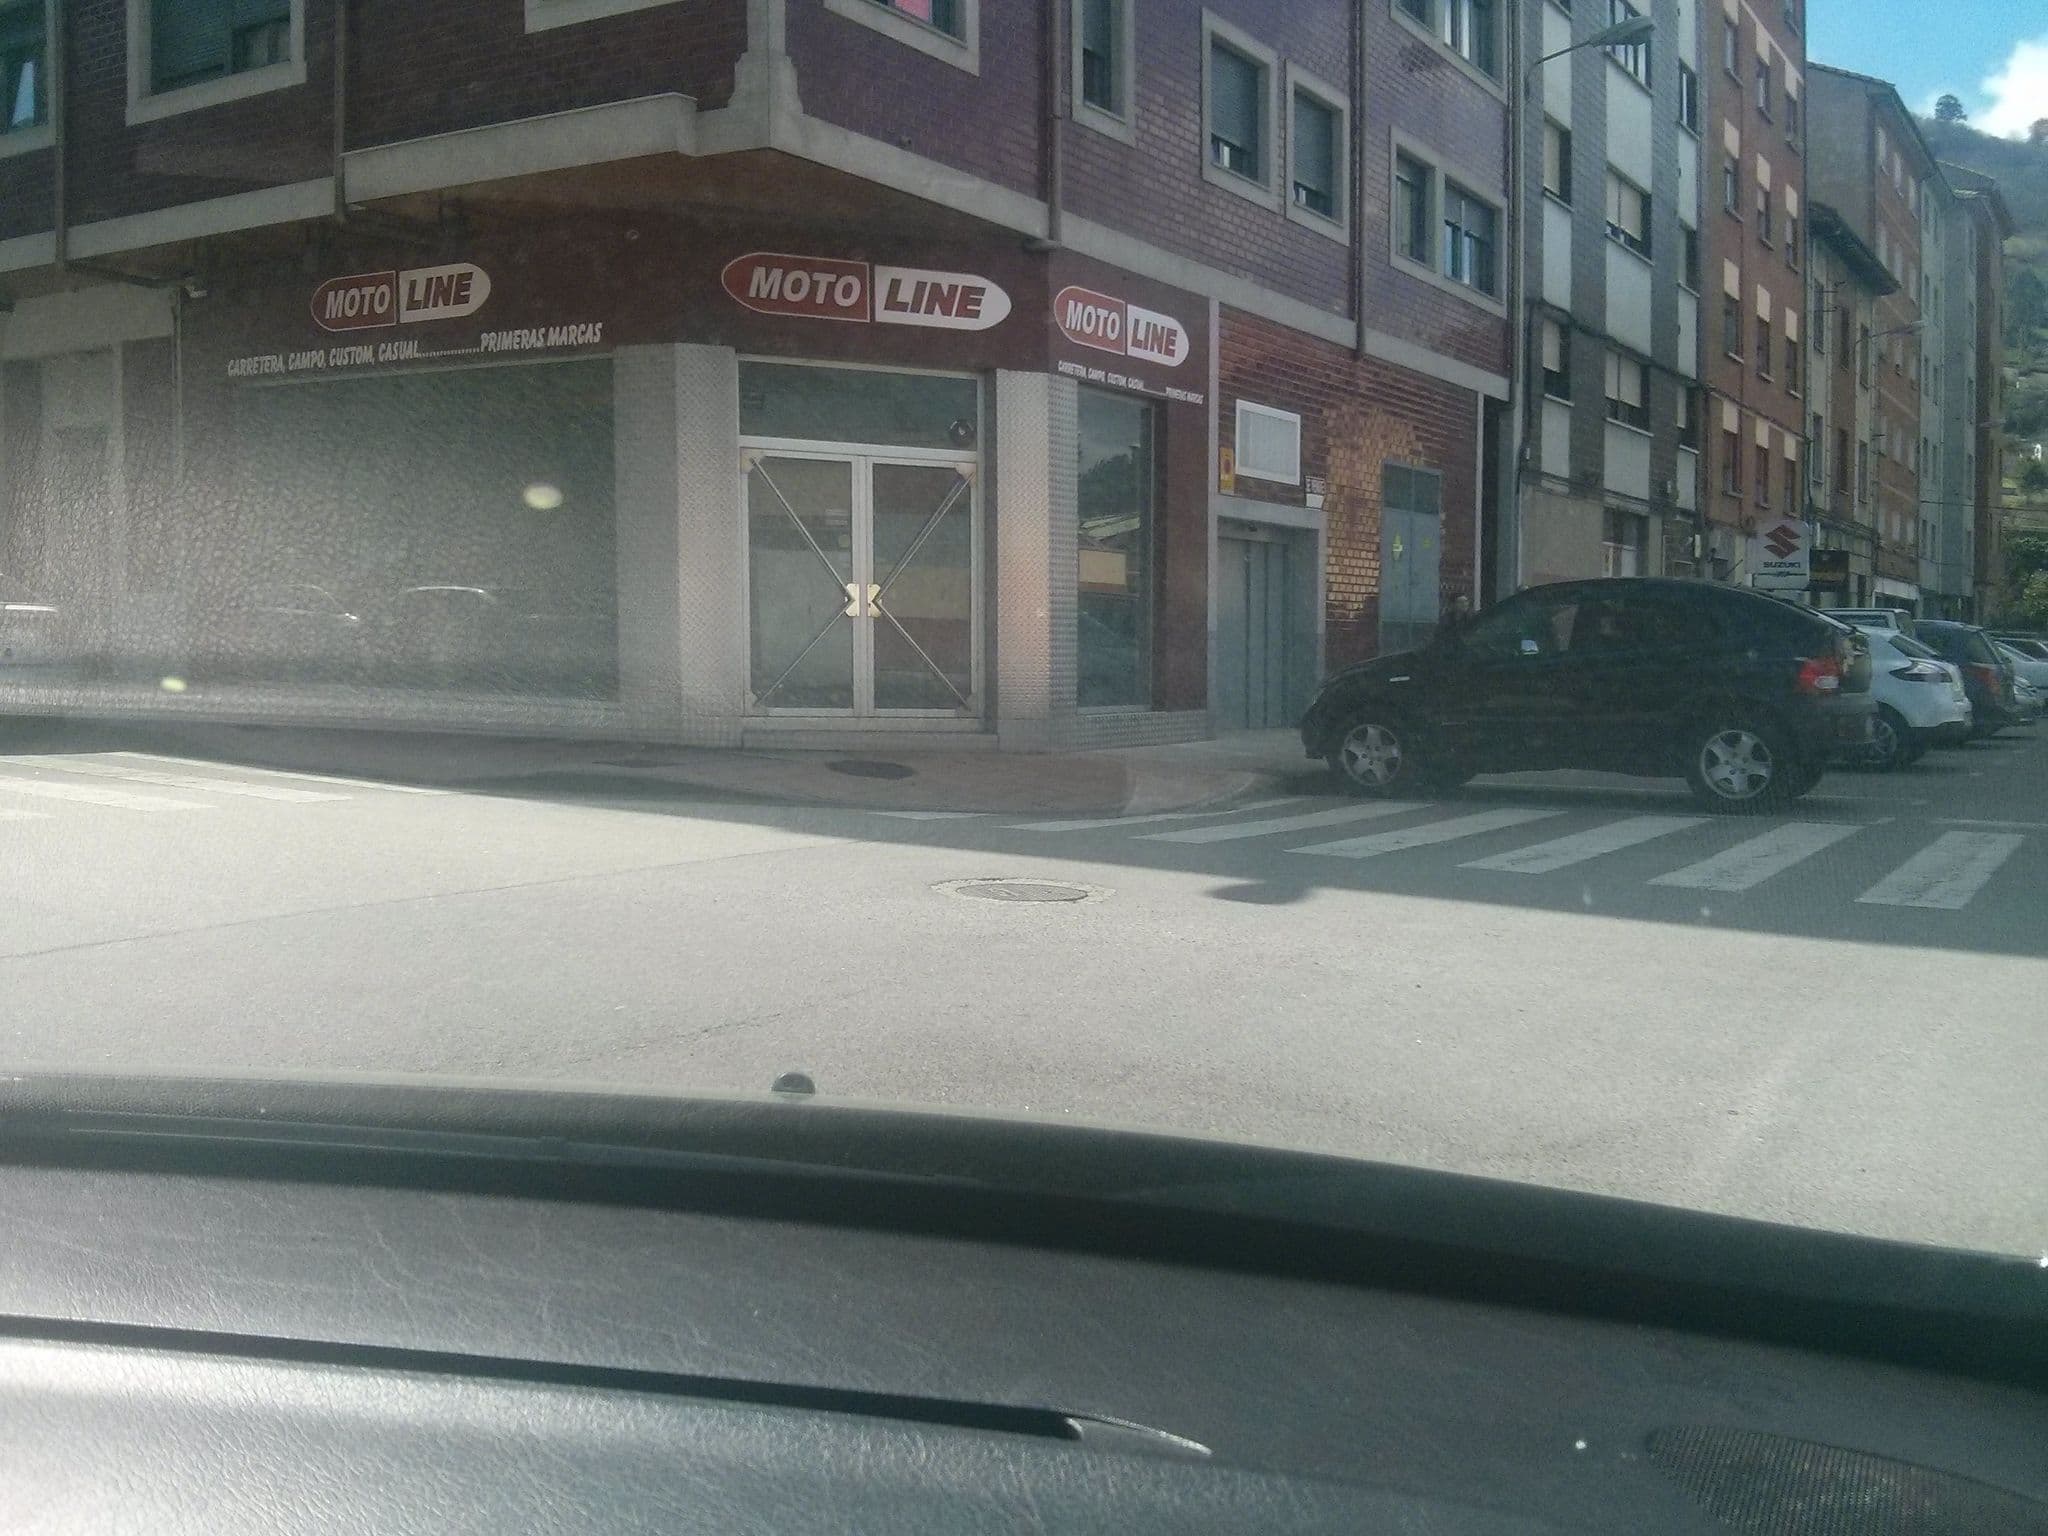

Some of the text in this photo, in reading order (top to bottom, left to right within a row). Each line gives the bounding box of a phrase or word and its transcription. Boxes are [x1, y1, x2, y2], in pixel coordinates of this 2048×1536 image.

[324, 271, 475, 320] MOTO LINE
[748, 266, 987, 319] MOTO LINE
[227, 354, 285, 376] CARRETERA,
[288, 350, 327, 370] CAMPO,
[329, 345, 375, 366] CUSTOM,
[547, 322, 603, 346] MARCAS
[1065, 299, 1178, 358] MOTO LINE
